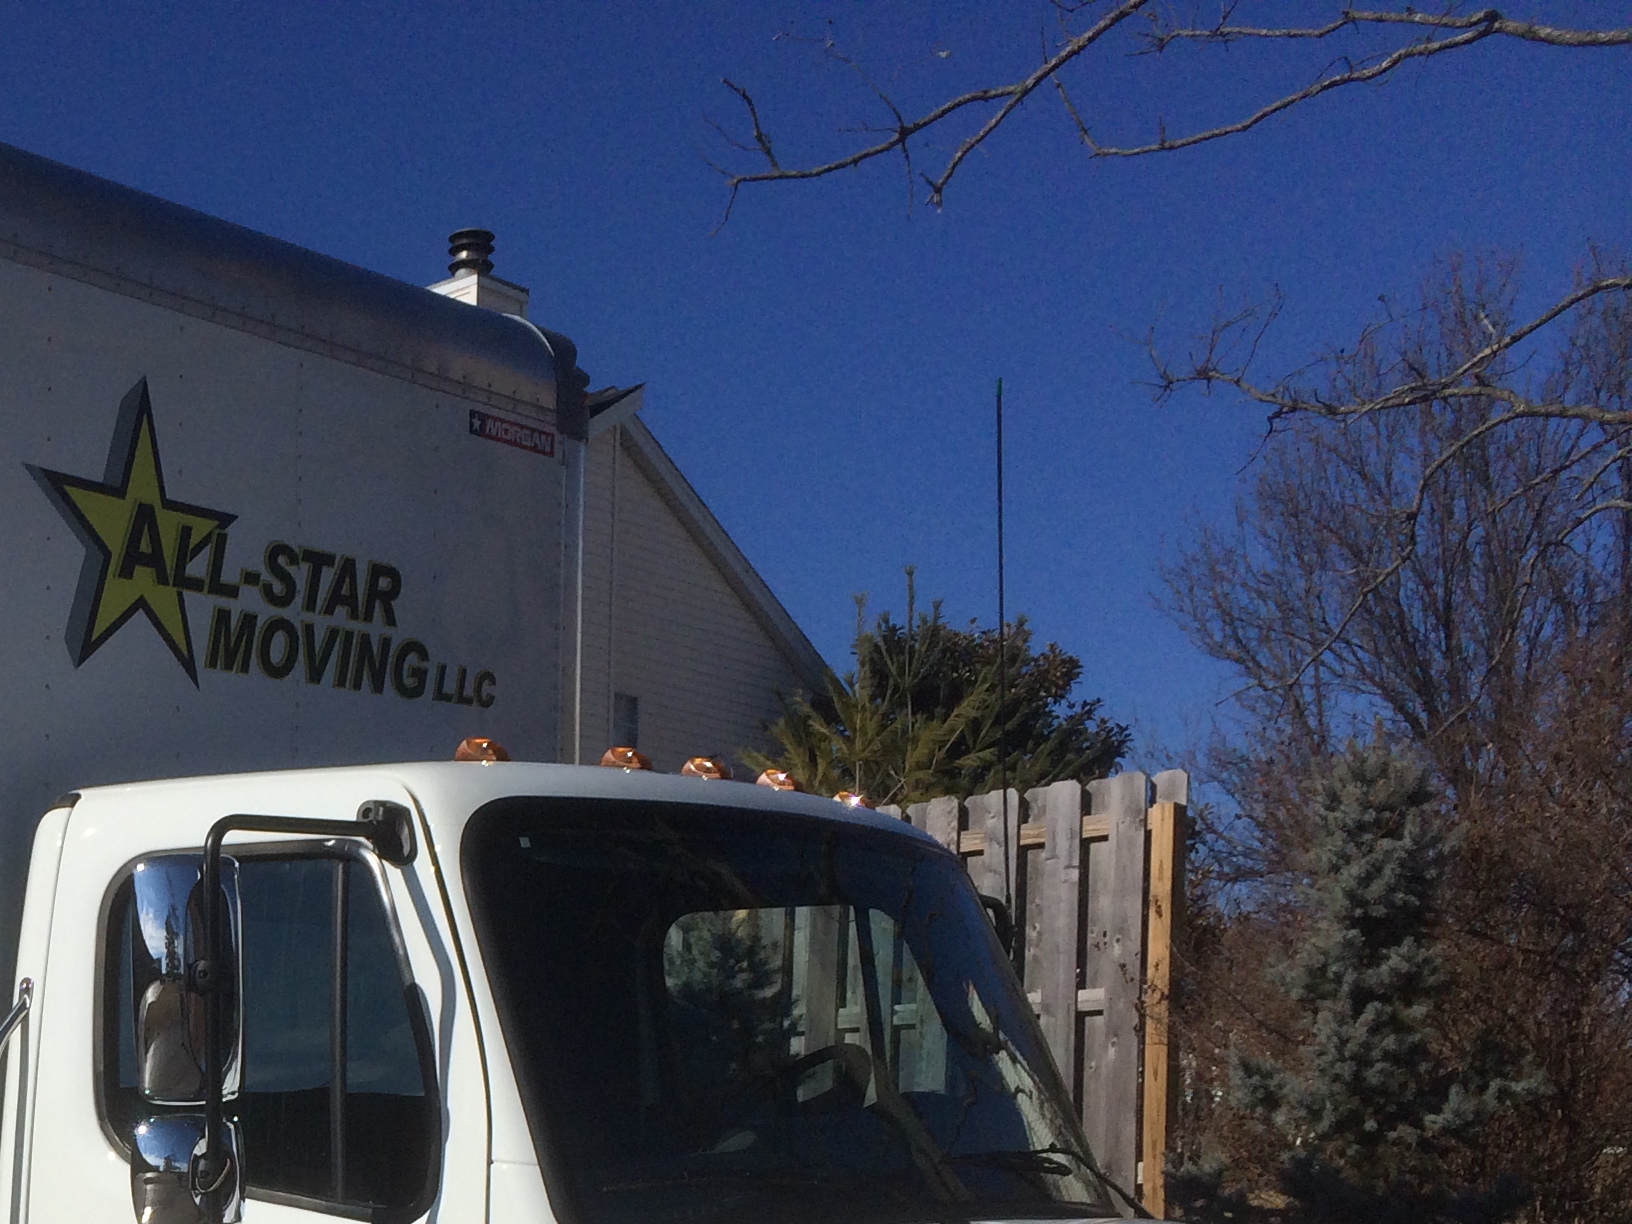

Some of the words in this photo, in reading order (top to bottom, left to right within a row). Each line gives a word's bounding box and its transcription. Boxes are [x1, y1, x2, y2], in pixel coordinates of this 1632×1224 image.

[485, 418, 552, 452] MORGAN
[115, 501, 401, 627] ALL-STAR
[204, 605, 430, 701] MOVING
[432, 662, 496, 708] LLC
